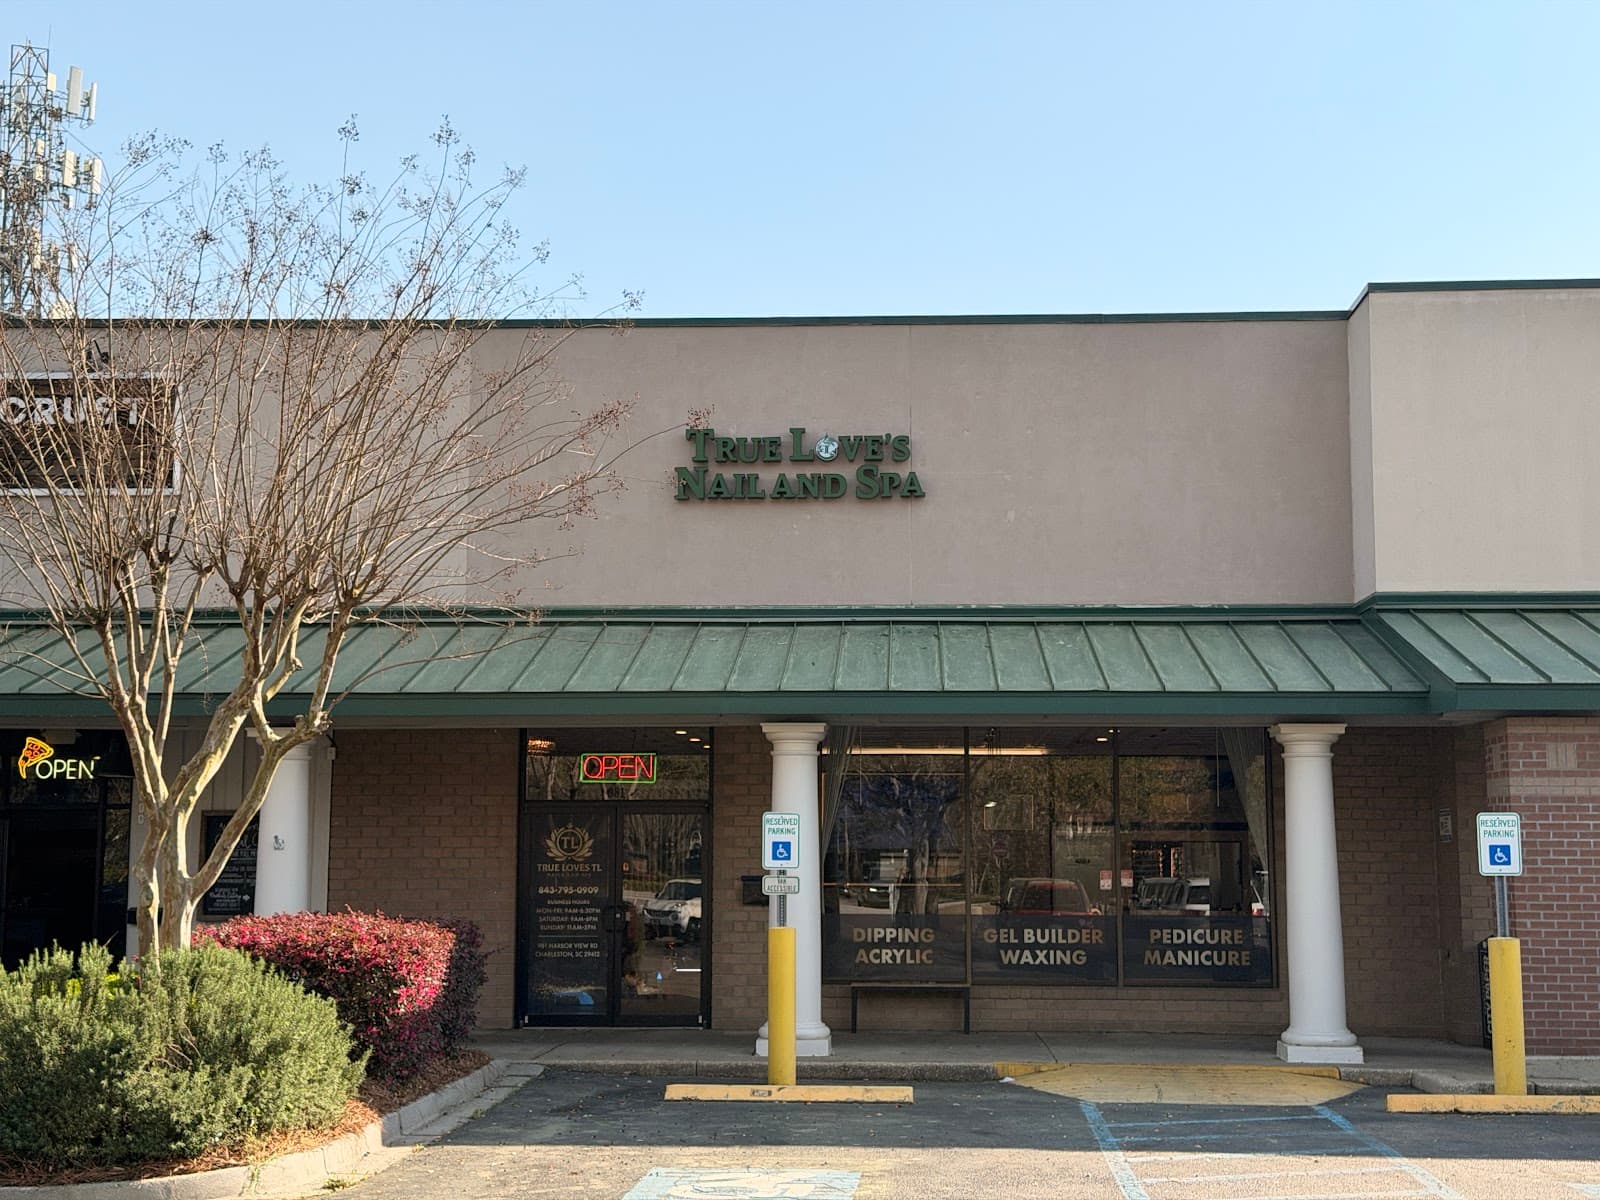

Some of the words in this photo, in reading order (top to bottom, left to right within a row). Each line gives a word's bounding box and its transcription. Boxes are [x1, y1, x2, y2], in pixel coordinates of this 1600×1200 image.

[685, 428, 782, 463] TRUE
[674, 466, 766, 500] NAIL
[770, 472, 848, 499] AND
[855, 464, 926, 500] SPA
[35, 758, 94, 779] OPEN
[583, 753, 653, 779] OPEN
[765, 817, 798, 826] RESERVED
[1480, 819, 1517, 828] RESERVED
[767, 827, 796, 835] PARKING
[1483, 830, 1515, 838] PARKING
[537, 863, 560, 872] TRUE
[561, 863, 590, 872] LOVES
[853, 928, 935, 943] DIPPING
[983, 928, 1019, 944] GEL
[1023, 928, 1104, 944] BUILDER
[1149, 928, 1243, 945] PEDICURE
[855, 948, 934, 964] ACRYLIC
[1000, 950, 1087, 965] WAXING
[1144, 950, 1251, 966] MANICURE
